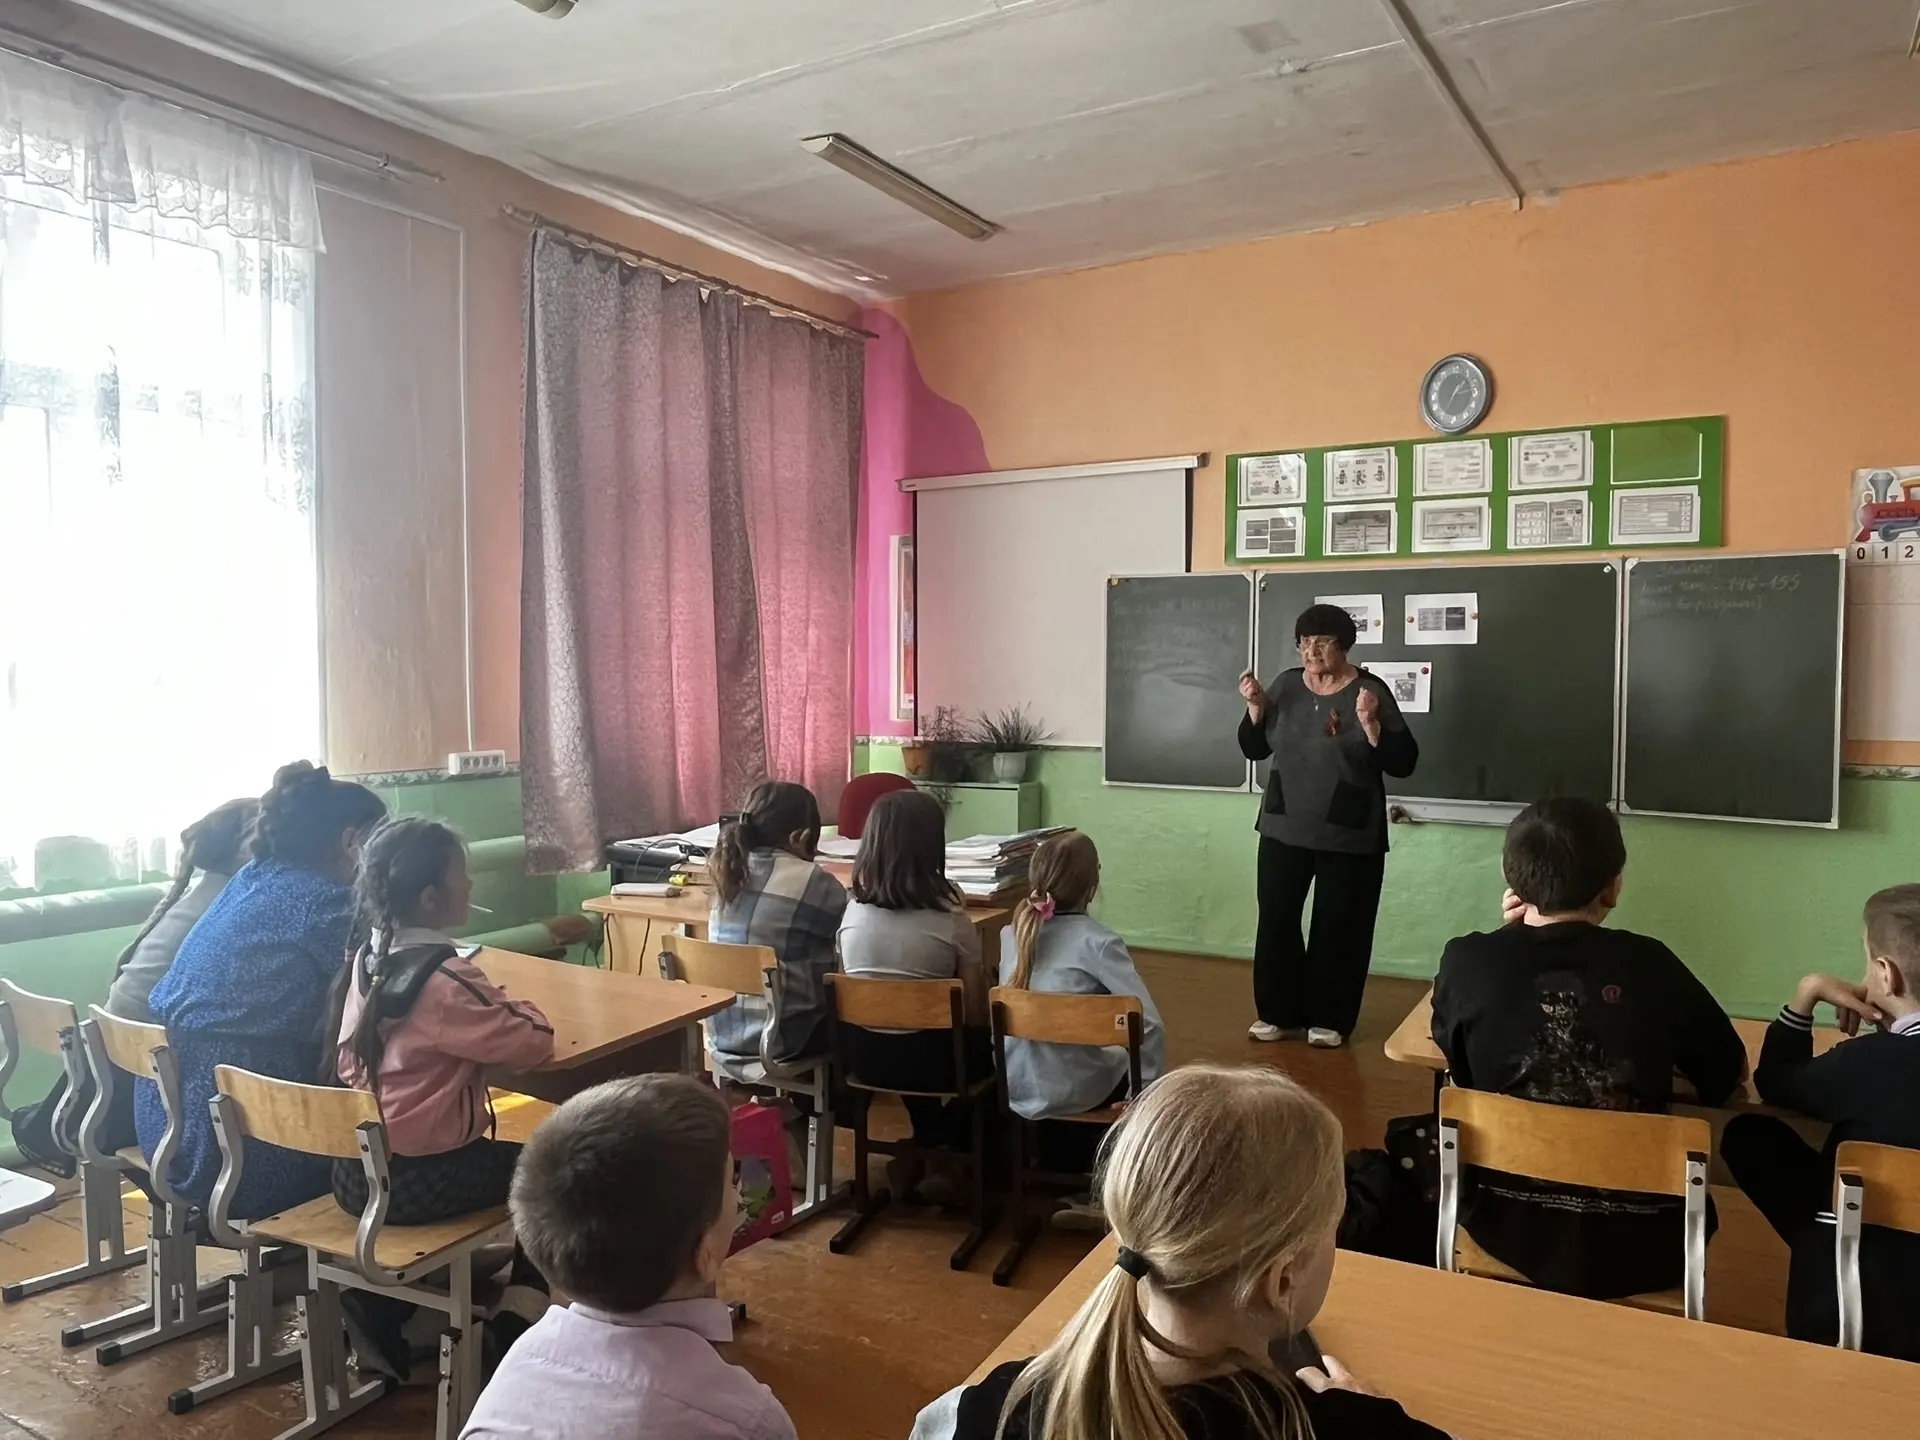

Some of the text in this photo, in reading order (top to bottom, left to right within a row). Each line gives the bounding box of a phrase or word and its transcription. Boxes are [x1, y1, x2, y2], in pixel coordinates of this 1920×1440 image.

[1856, 544, 1914, 560] 0 1 2
[1116, 1016, 1125, 1028] 4
